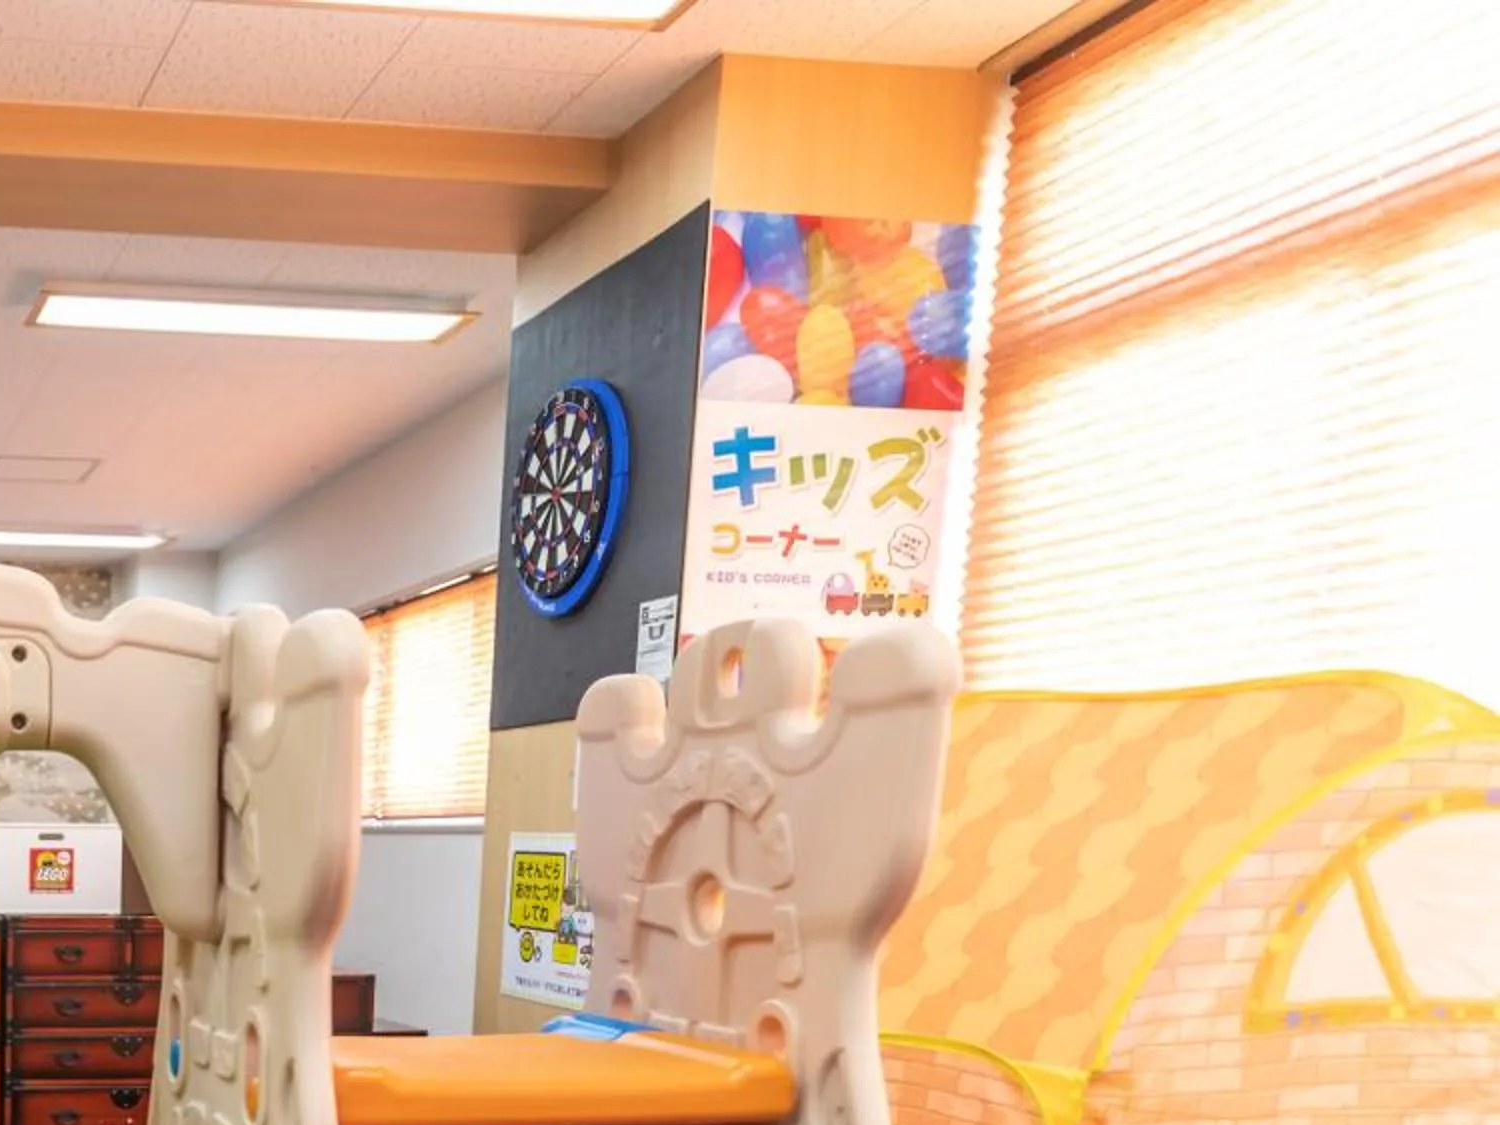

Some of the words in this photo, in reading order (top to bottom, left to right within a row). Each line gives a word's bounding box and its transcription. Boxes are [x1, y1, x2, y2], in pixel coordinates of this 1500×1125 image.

[712, 426, 941, 511] キッズ
[710, 522, 841, 558] コーナー
[753, 573, 812, 585] CORNER
[516, 861, 561, 881] あそんだら
[522, 903, 549, 923] してね
